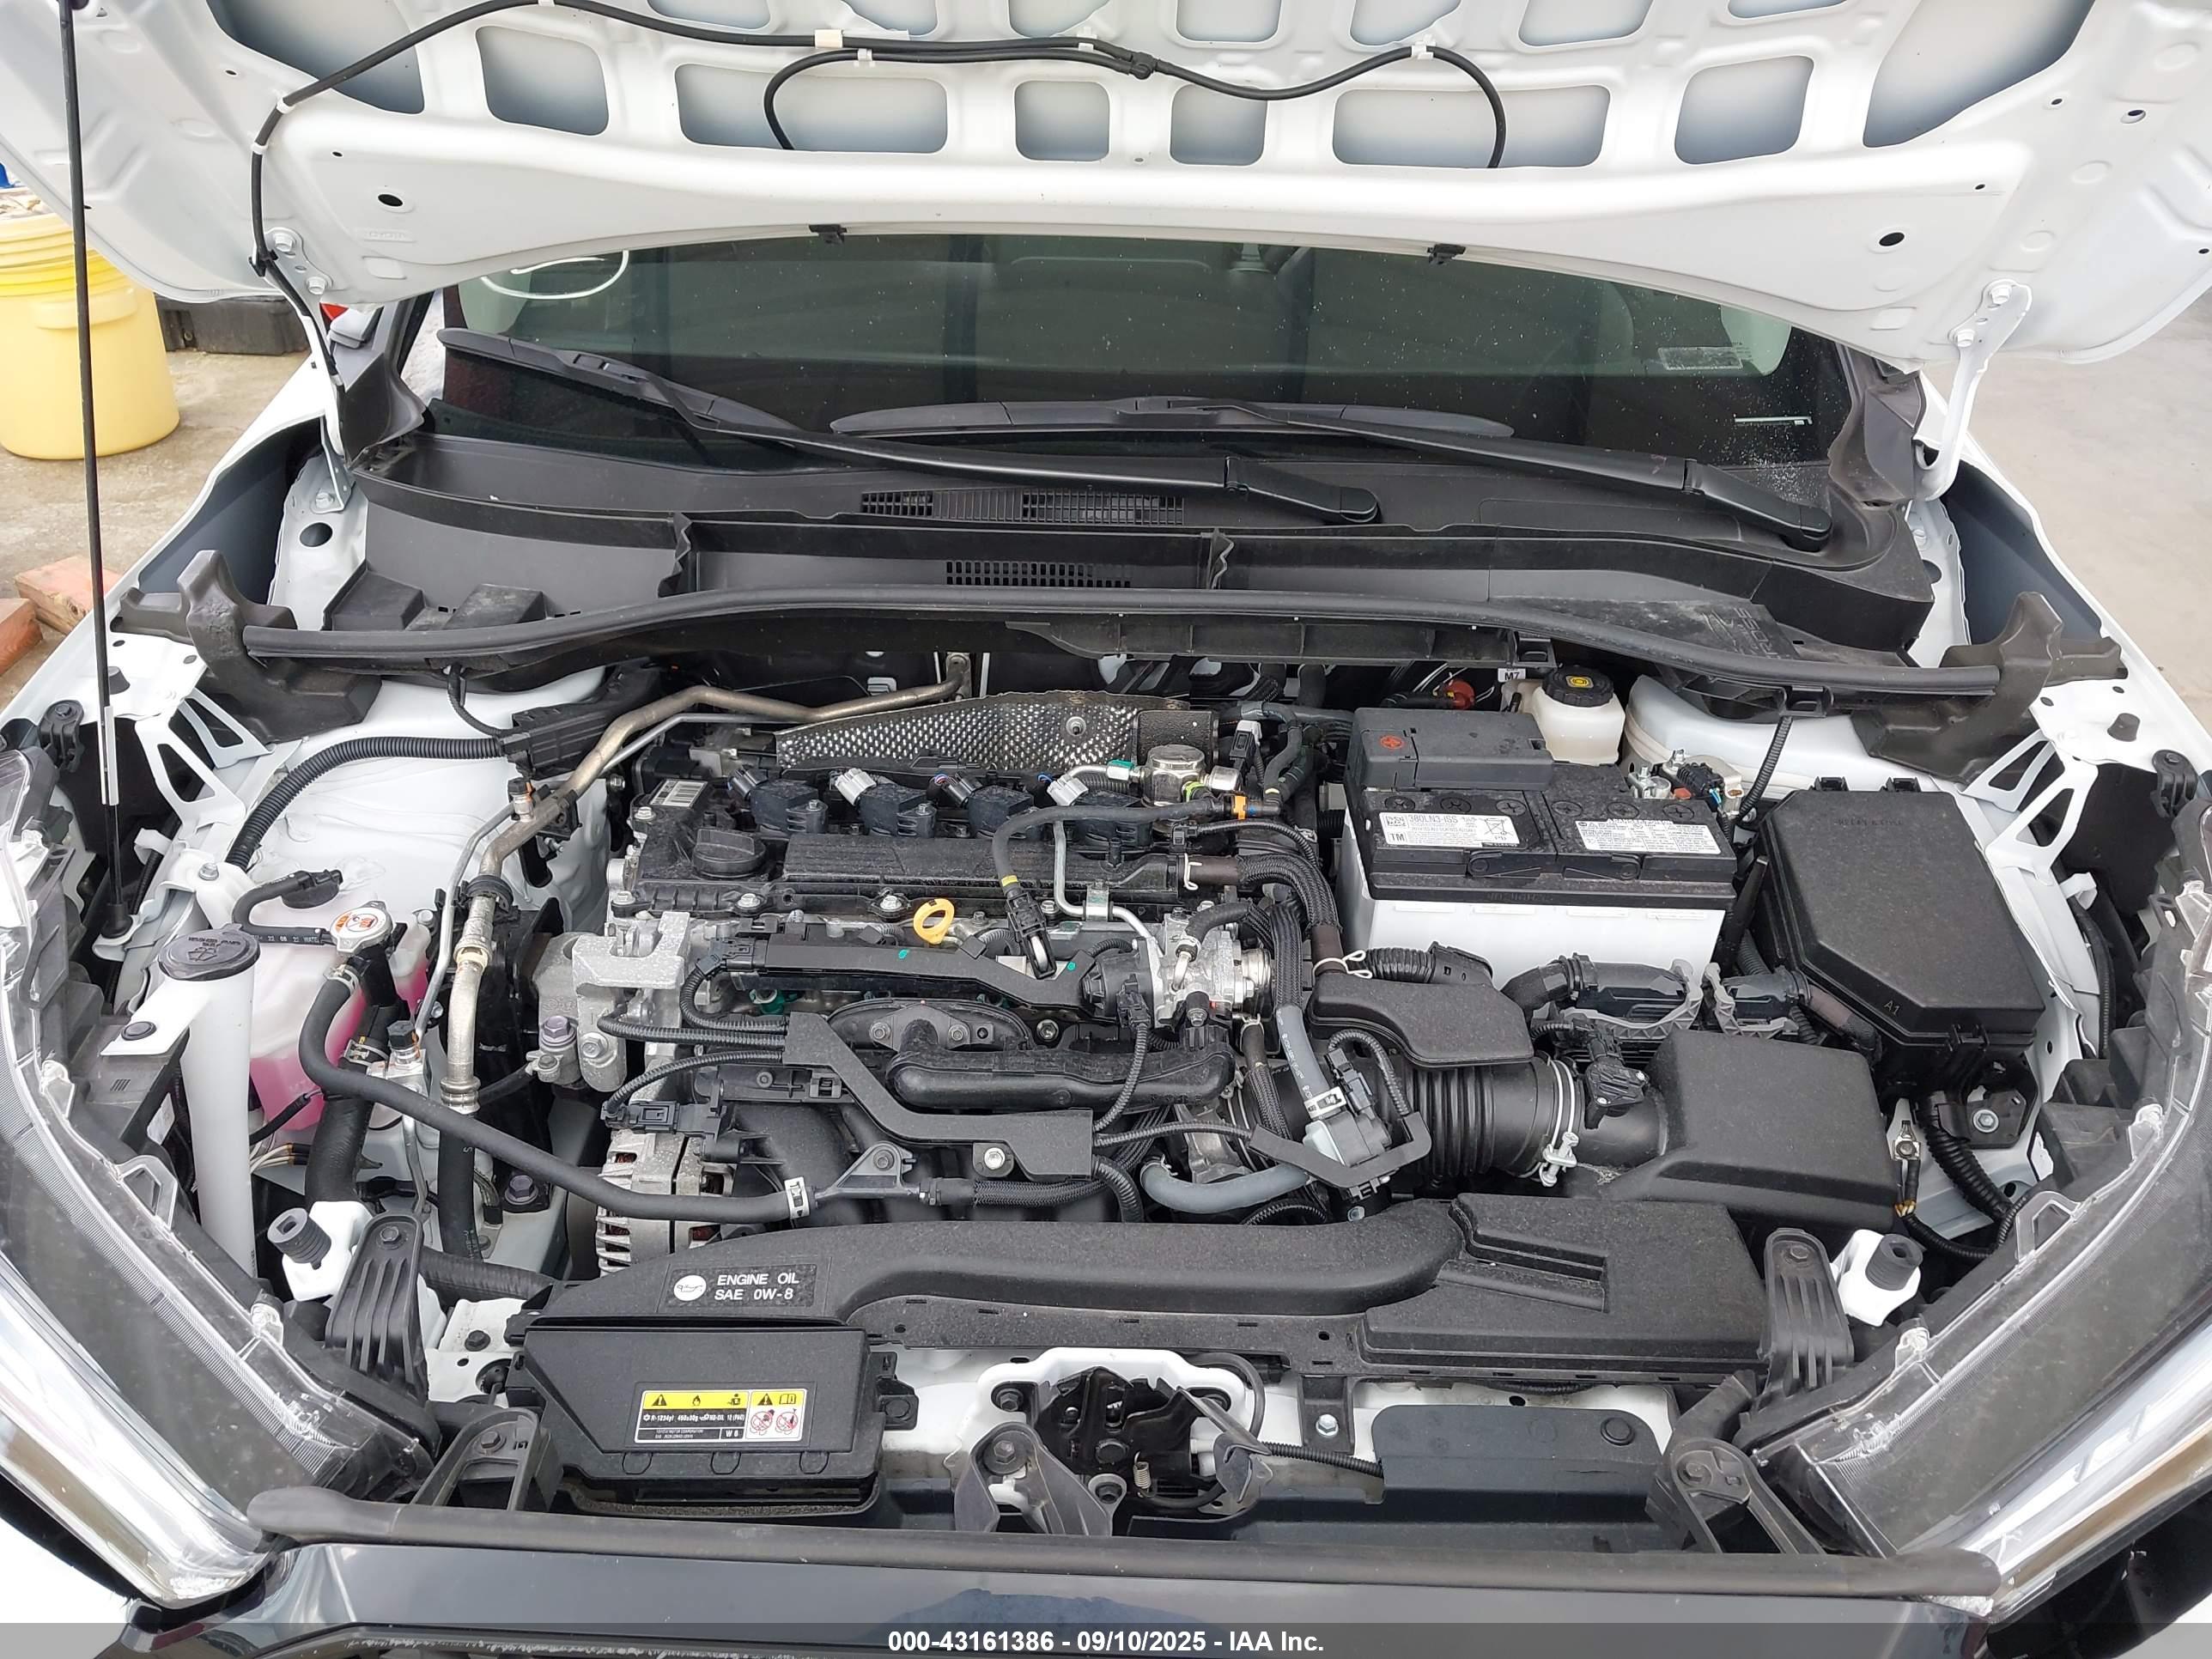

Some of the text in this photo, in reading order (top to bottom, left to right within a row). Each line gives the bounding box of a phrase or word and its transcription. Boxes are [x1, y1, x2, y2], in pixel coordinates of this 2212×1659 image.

[1884, 1000, 1900, 1015] A1
[717, 1272, 799, 1286] ENGINE OIL
[714, 1287, 794, 1301] SAE 0W-8
